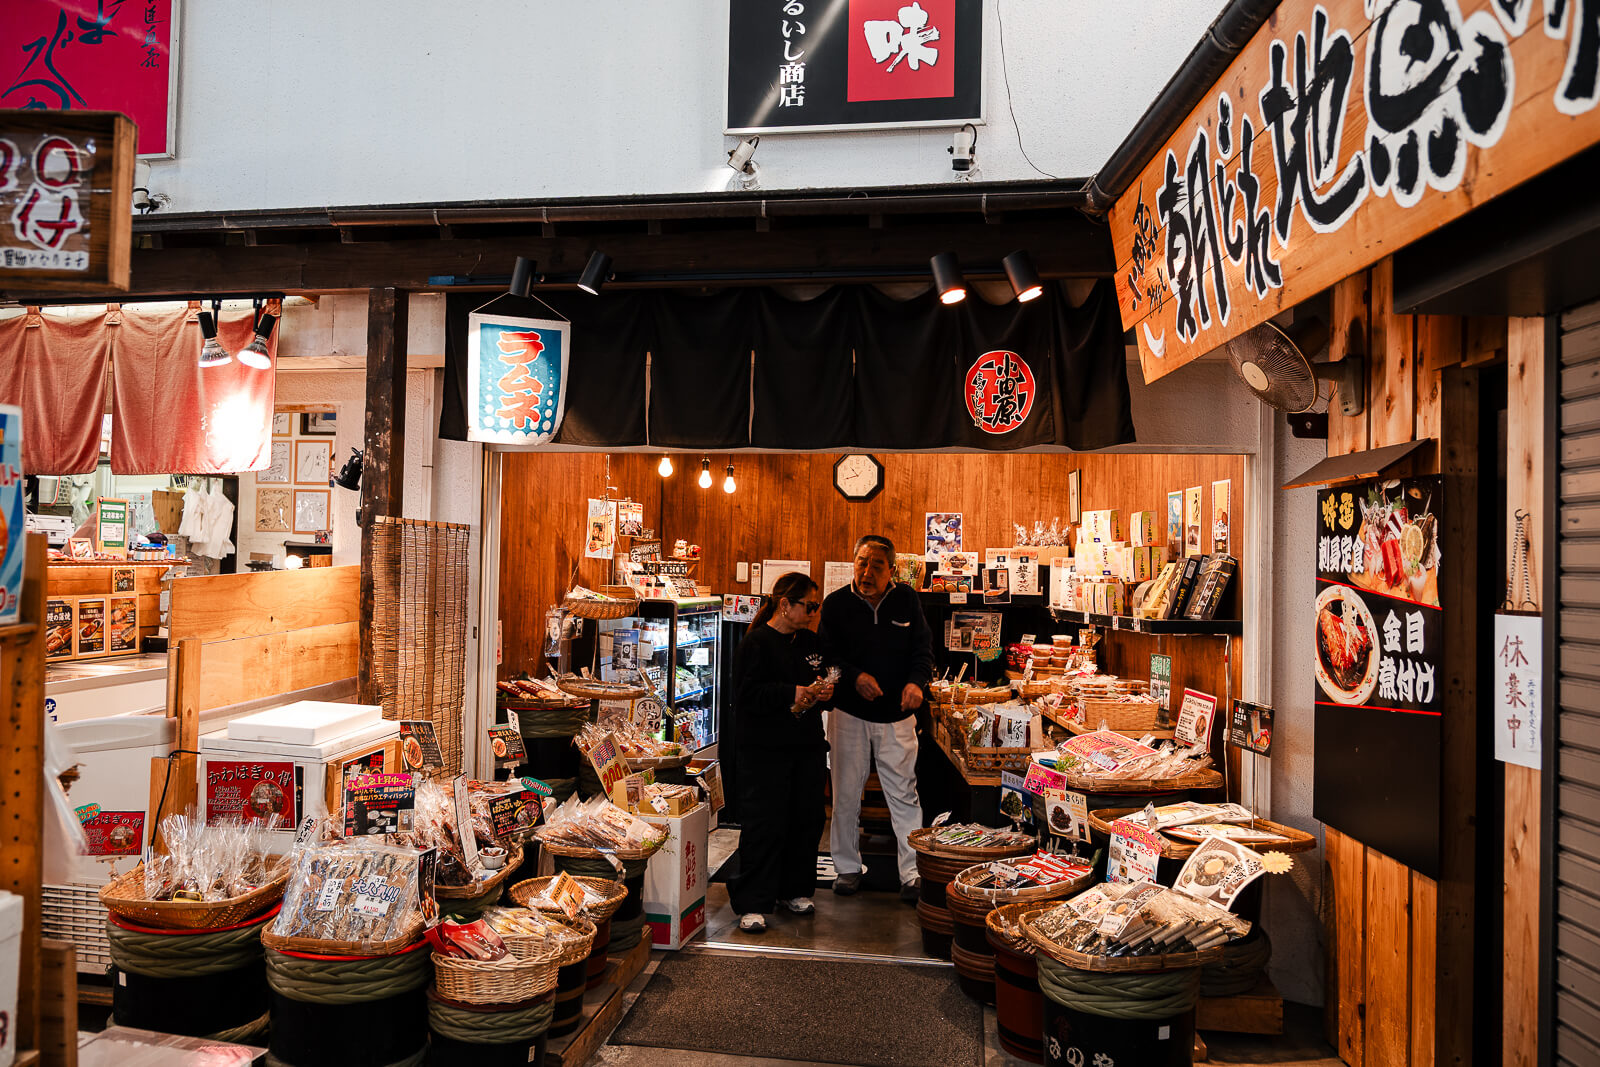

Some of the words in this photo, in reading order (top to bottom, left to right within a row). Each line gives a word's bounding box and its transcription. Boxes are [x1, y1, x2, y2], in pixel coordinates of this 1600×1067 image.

[863, 1, 940, 73] 味
[497, 331, 544, 429] ラムネ
[1318, 535, 1365, 573] 刺身定食
[1382, 609, 1425, 654] 金目
[1379, 657, 1434, 703] 煮付け
[1499, 634, 1529, 748] 休業中
